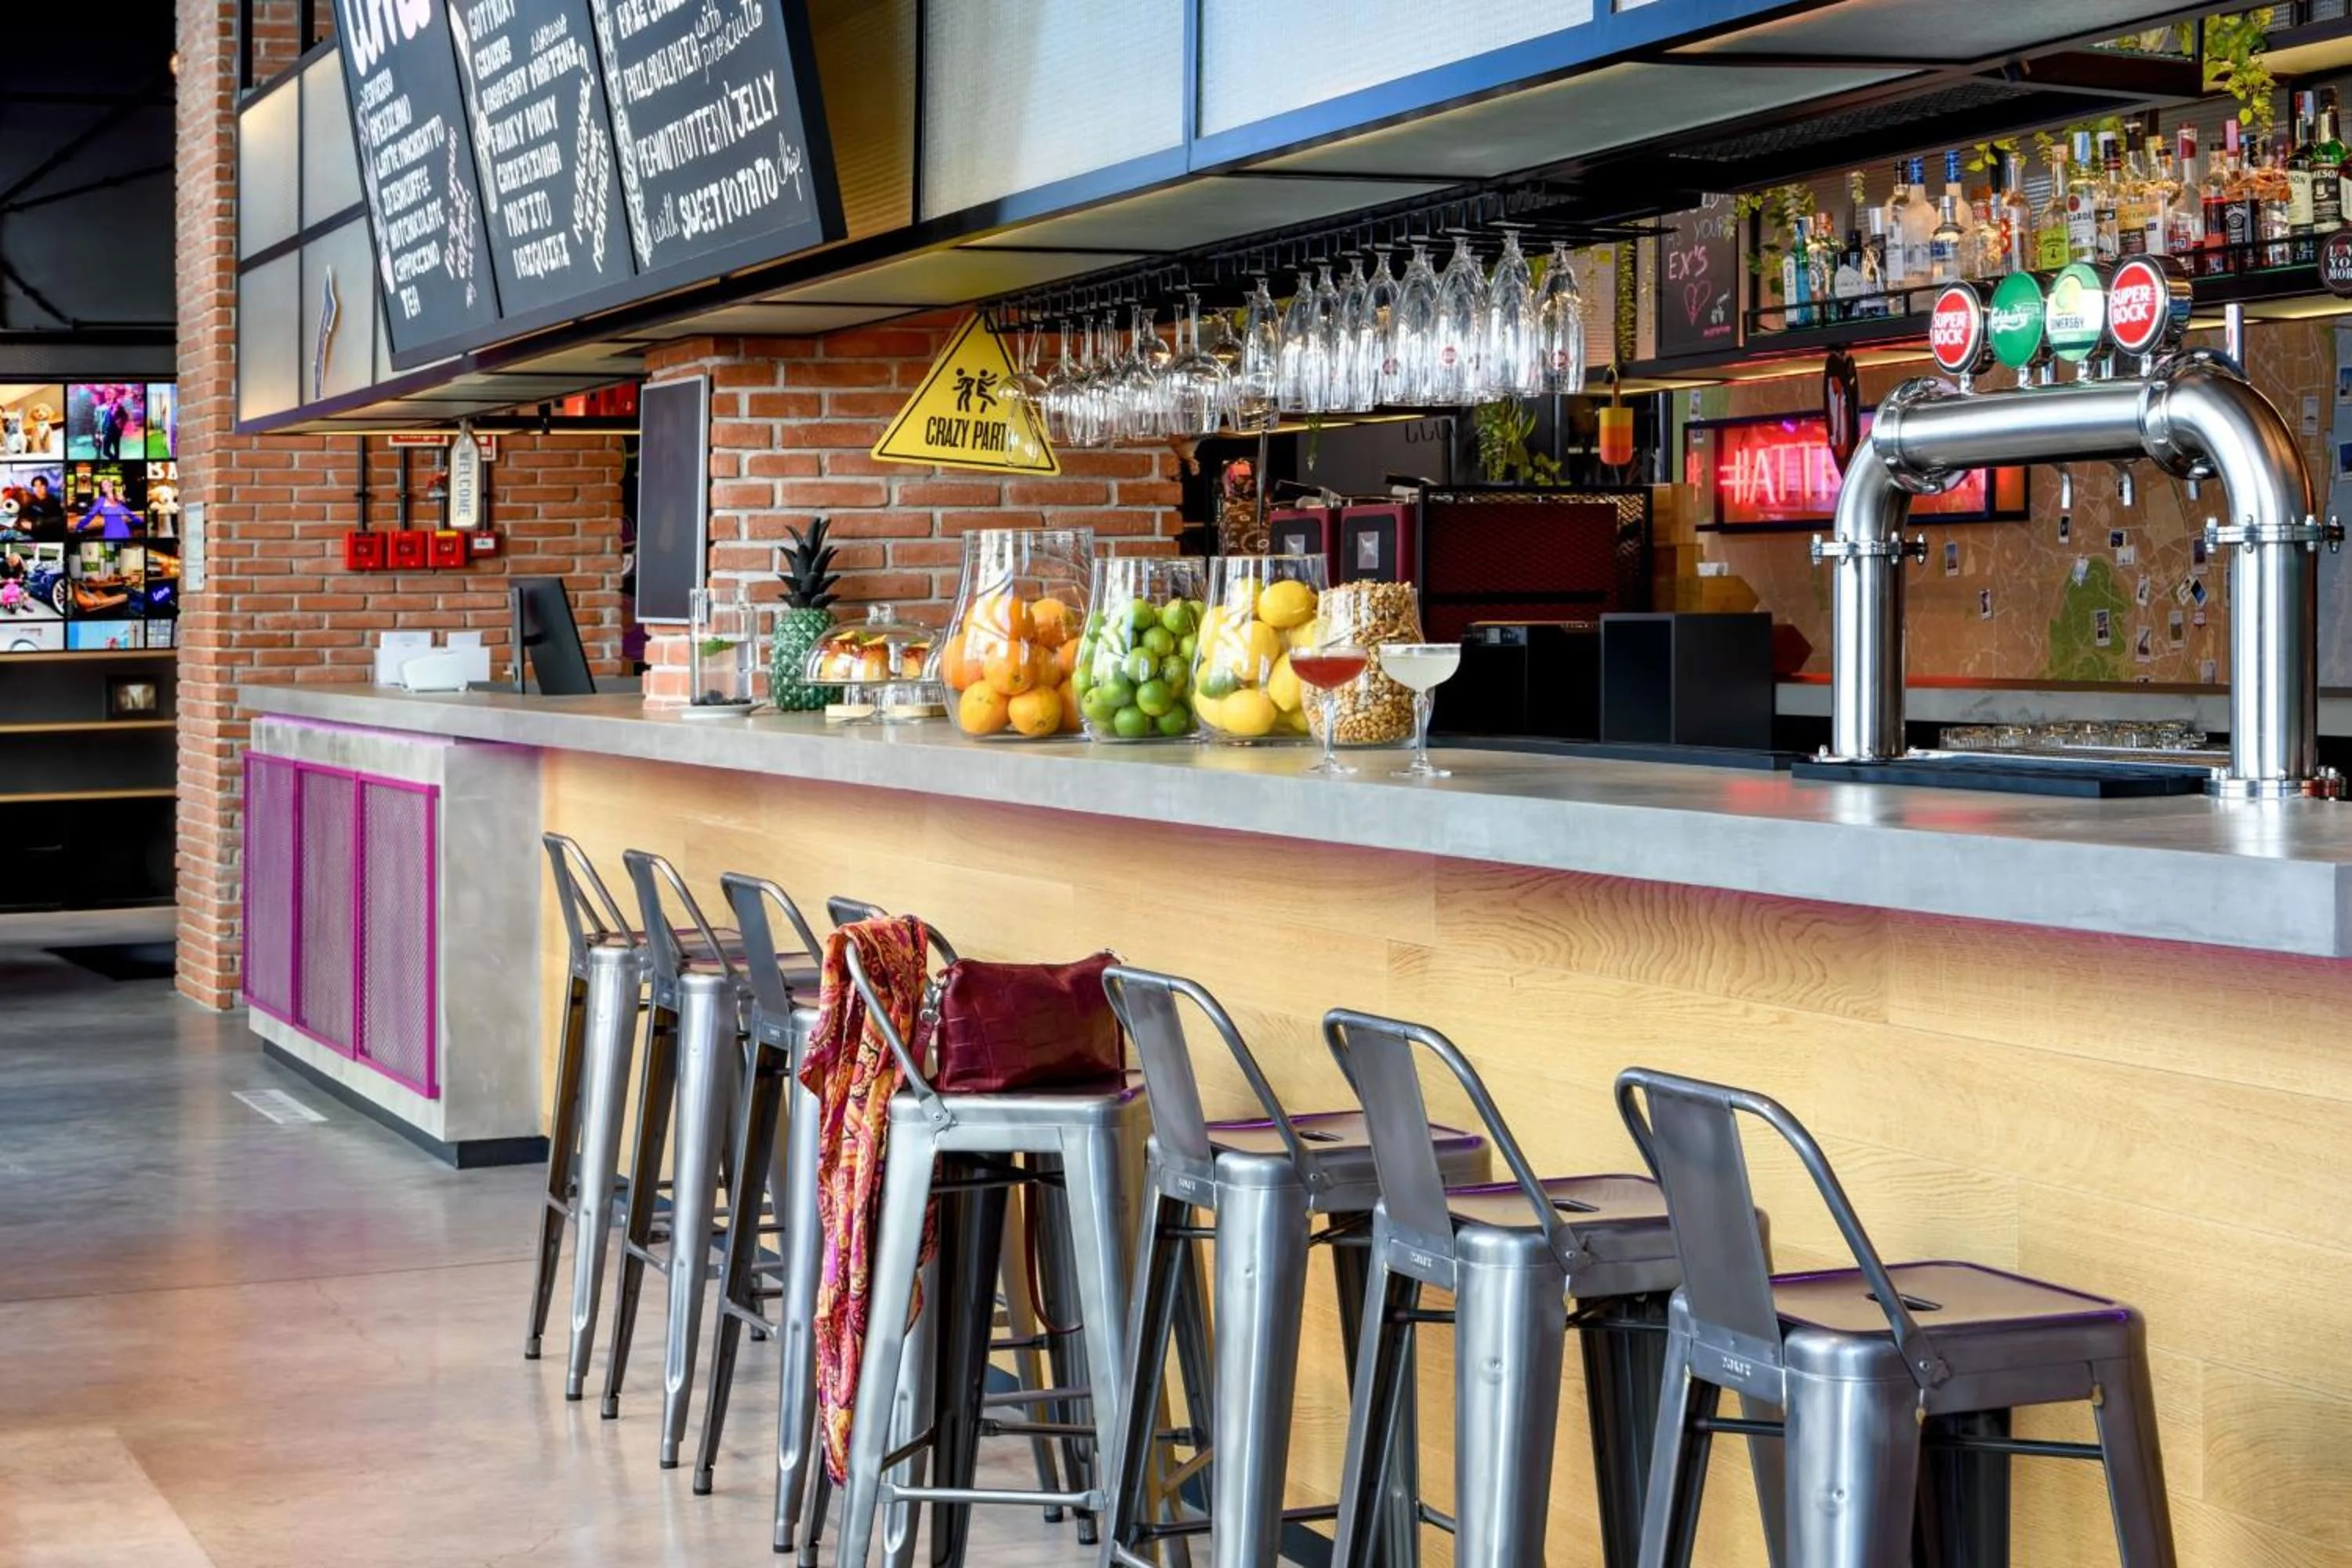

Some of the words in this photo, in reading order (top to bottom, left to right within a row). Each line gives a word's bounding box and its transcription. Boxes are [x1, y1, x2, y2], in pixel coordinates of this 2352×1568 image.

[528, 36, 579, 90] MARTINI
[623, 32, 702, 103] PHILADELPHIA
[730, 69, 779, 138] JELLY
[503, 190, 552, 237] MOJITO
[679, 182, 724, 241] SWEET
[720, 157, 779, 223] POTATO
[2328, 258, 2351, 269] YO
[2328, 268, 2352, 281] MOR
[400, 285, 421, 320] TEA
[2111, 285, 2150, 306] SUPER
[1934, 312, 1966, 329] SUPER
[2113, 303, 2149, 325] BOCK
[1934, 328, 1965, 345] BOCK
[925, 416, 970, 448] CRAZY
[458, 452, 472, 517] WELCOME
